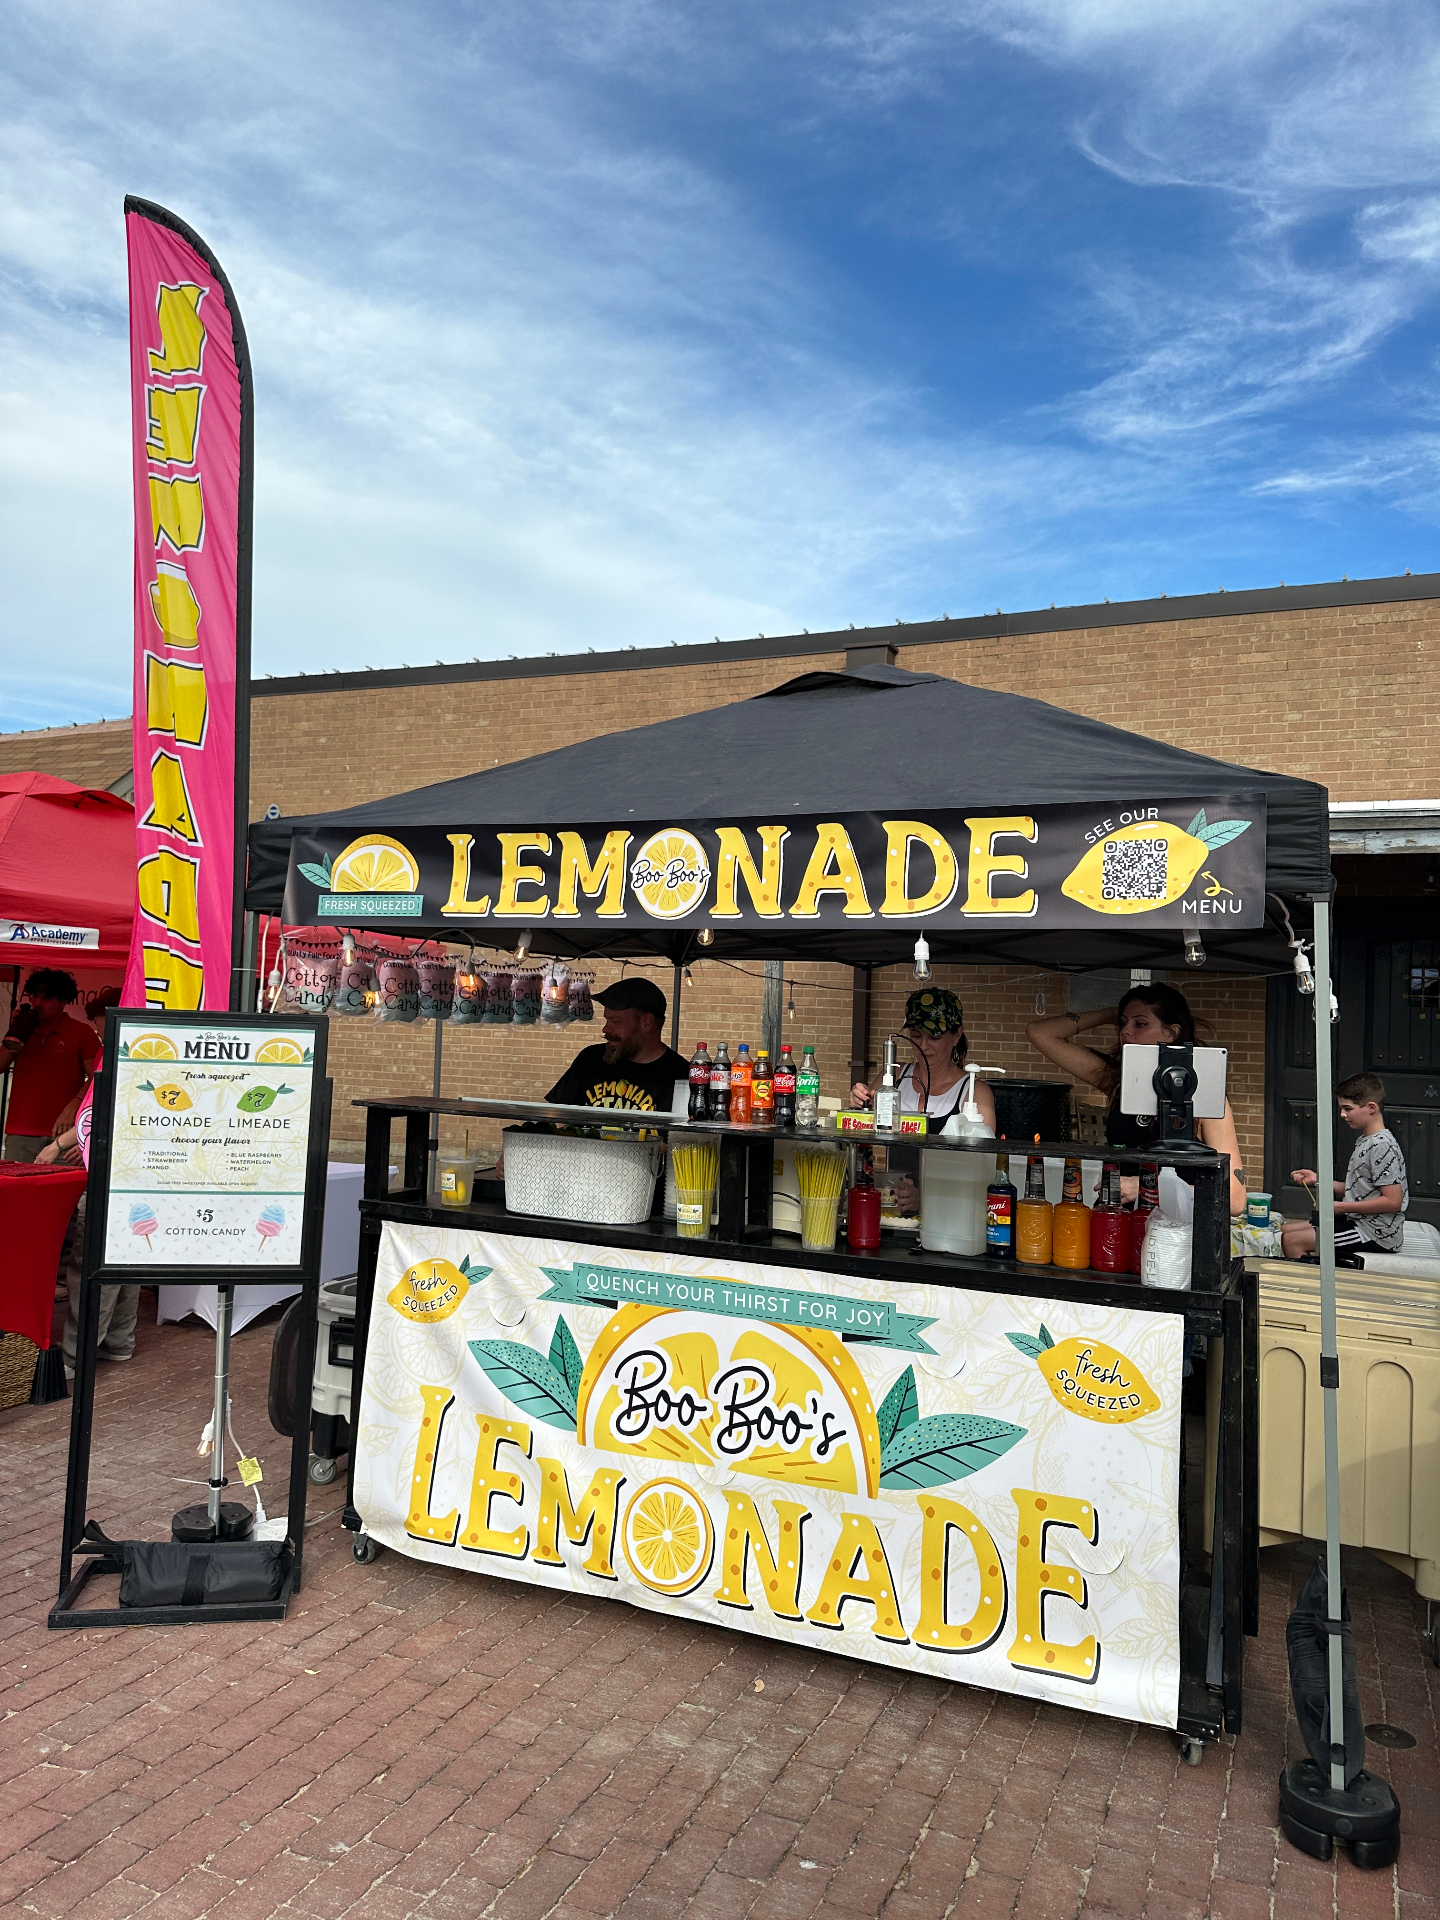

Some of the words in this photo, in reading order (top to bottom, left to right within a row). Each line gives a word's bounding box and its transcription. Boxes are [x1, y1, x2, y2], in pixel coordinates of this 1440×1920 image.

[1084, 818, 1115, 844] SEE
[1119, 807, 1159, 824] OUR
[441, 816, 1039, 921] LEMONADE
[632, 858, 664, 889] Boo
[665, 857, 710, 888] Boo's
[325, 900, 358, 912] FRESH
[361, 899, 415, 912] SQUEEZED
[1182, 899, 1242, 914] MENU
[31, 926, 86, 944] Academy
[286, 967, 337, 988] Cotton
[347, 972, 371, 991] Cot
[385, 977, 420, 995] Cotto
[420, 979, 455, 995] Cotto
[285, 985, 334, 1012] Candy
[385, 994, 420, 1015] Cand
[184, 1040, 252, 1060] MENU
[181, 1071, 206, 1081] fresh
[207, 1073, 251, 1082] squeezed
[797, 1076, 819, 1087] Sprite
[161, 1090, 181, 1106] $7
[247, 1092, 266, 1107] $7
[585, 1080, 657, 1109] LEMONAD
[130, 1116, 212, 1128] LEMONADE
[229, 1118, 291, 1129] LIMEADE
[171, 1136, 200, 1144] choose
[201, 1138, 223, 1147] your
[223, 1137, 251, 1147] flavor
[196, 1209, 214, 1223] $5
[166, 1228, 208, 1236] COTTON
[212, 1228, 246, 1236] CANDY
[409, 1266, 448, 1296] fresh
[402, 1284, 458, 1312] SQUEEZED
[586, 1273, 659, 1296] QUENCH
[665, 1282, 715, 1304] YOUR
[722, 1290, 790, 1314] THIRST
[799, 1301, 837, 1321] FOR
[845, 1309, 885, 1327] JOY
[1075, 1349, 1130, 1388] fresh
[1056, 1369, 1141, 1410] SQUEEZED
[613, 1350, 707, 1437] Boo
[714, 1364, 847, 1457] Boo's
[404, 1384, 1102, 1686] LEMONADE
